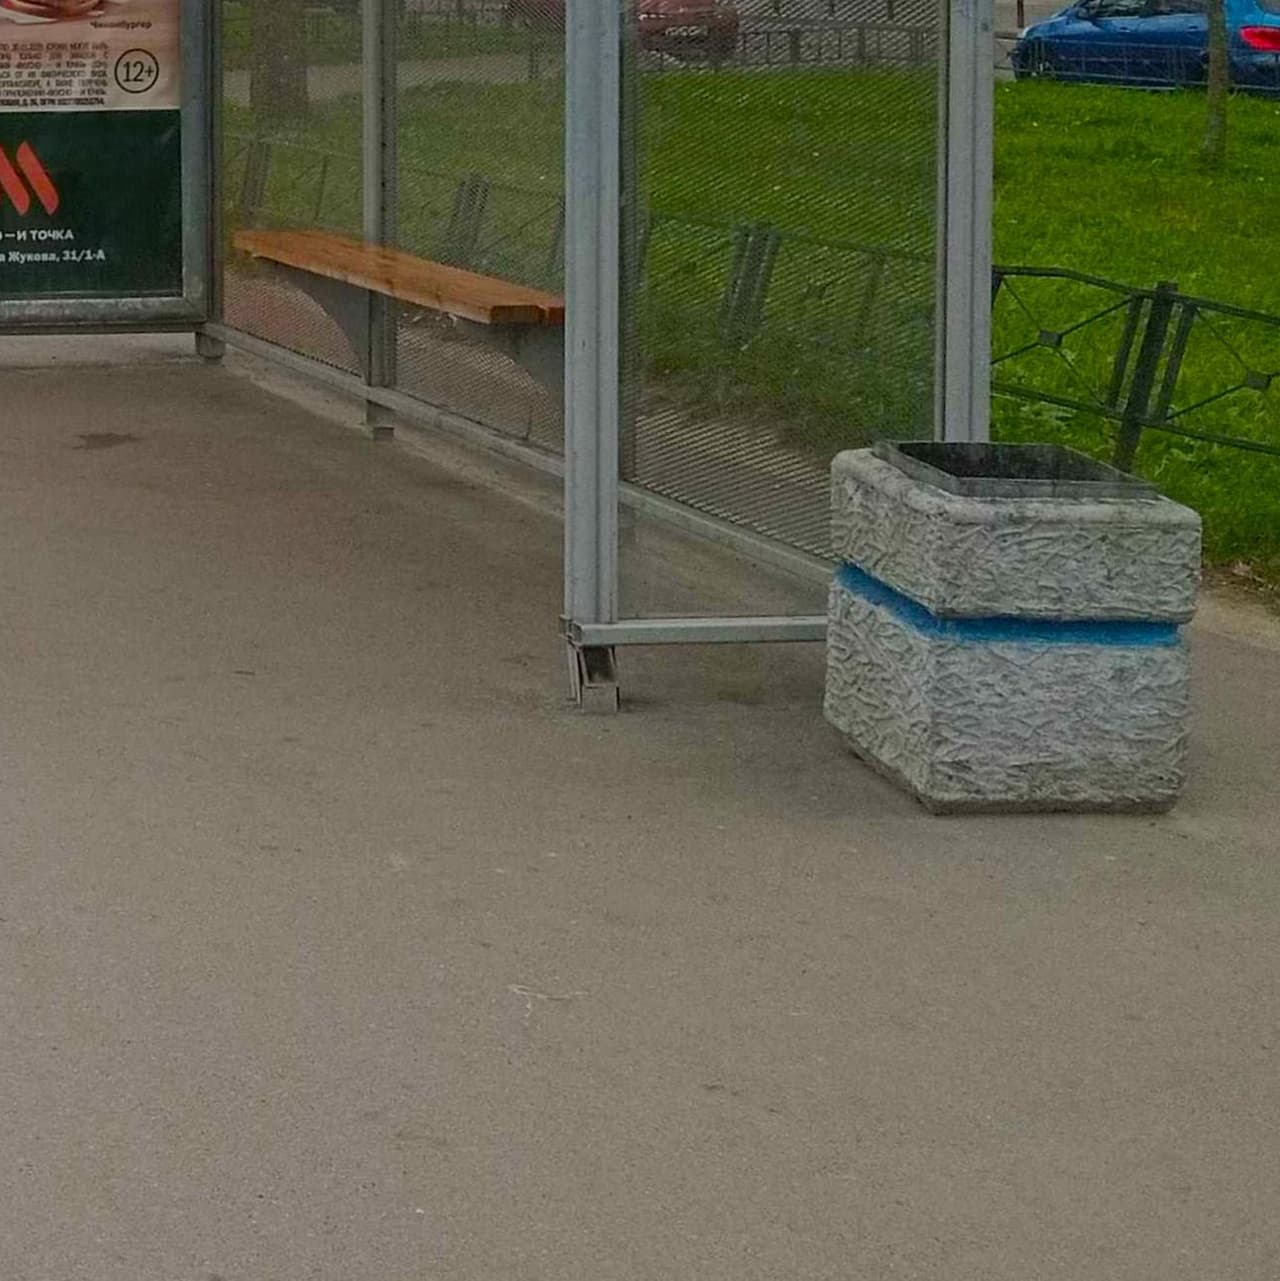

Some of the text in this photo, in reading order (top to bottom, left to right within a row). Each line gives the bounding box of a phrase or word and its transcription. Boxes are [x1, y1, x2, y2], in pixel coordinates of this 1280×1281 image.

[122, 60, 154, 83] 12+
[29, 229, 75, 241] ТОЧКА
[8, 251, 60, 264] Жукова,
